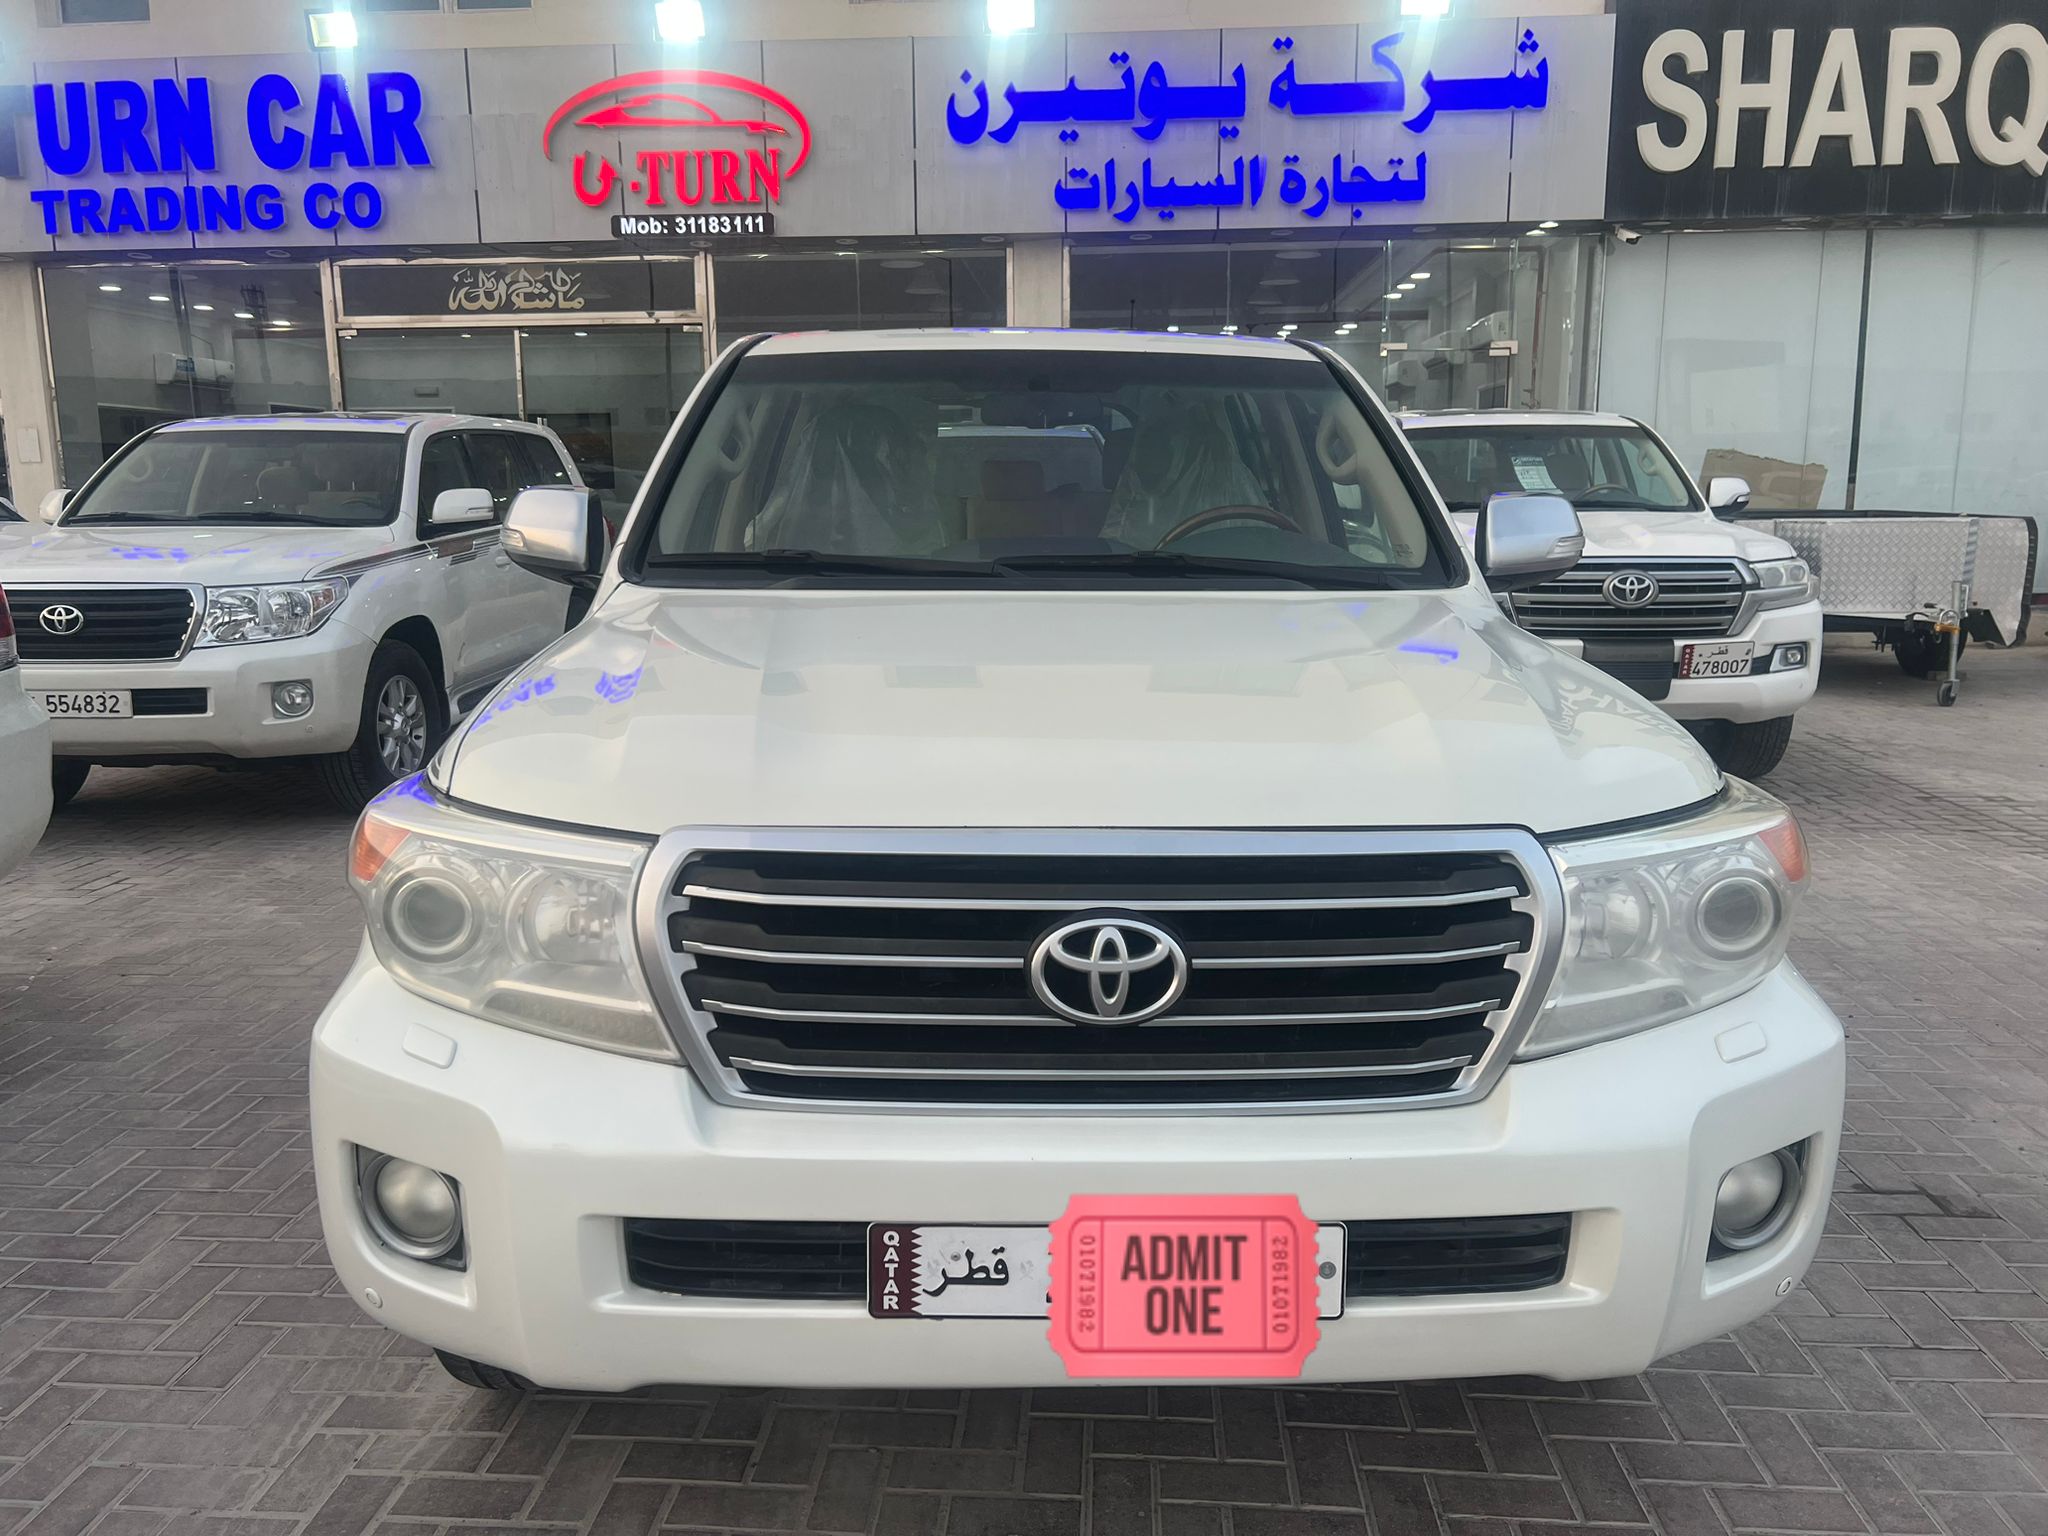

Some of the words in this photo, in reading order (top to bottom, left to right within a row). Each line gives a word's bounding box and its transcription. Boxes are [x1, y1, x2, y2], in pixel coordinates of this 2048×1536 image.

[946, 51, 1246, 144] يوتيرن
[1269, 28, 1549, 133] شركة
[246, 71, 432, 171] CAR
[30, 184, 286, 236] TRADING
[303, 181, 384, 231] CO
[1054, 154, 1266, 223] السيارات
[1279, 151, 1427, 219] لتجارة
[620, 218, 669, 235] Mob:
[675, 215, 764, 234] 31183111
[1692, 659, 1749, 676] 478007
[45, 694, 121, 714] 554832
[882, 1230, 900, 1310] QATAR
[922, 1246, 1010, 1297] قطر
